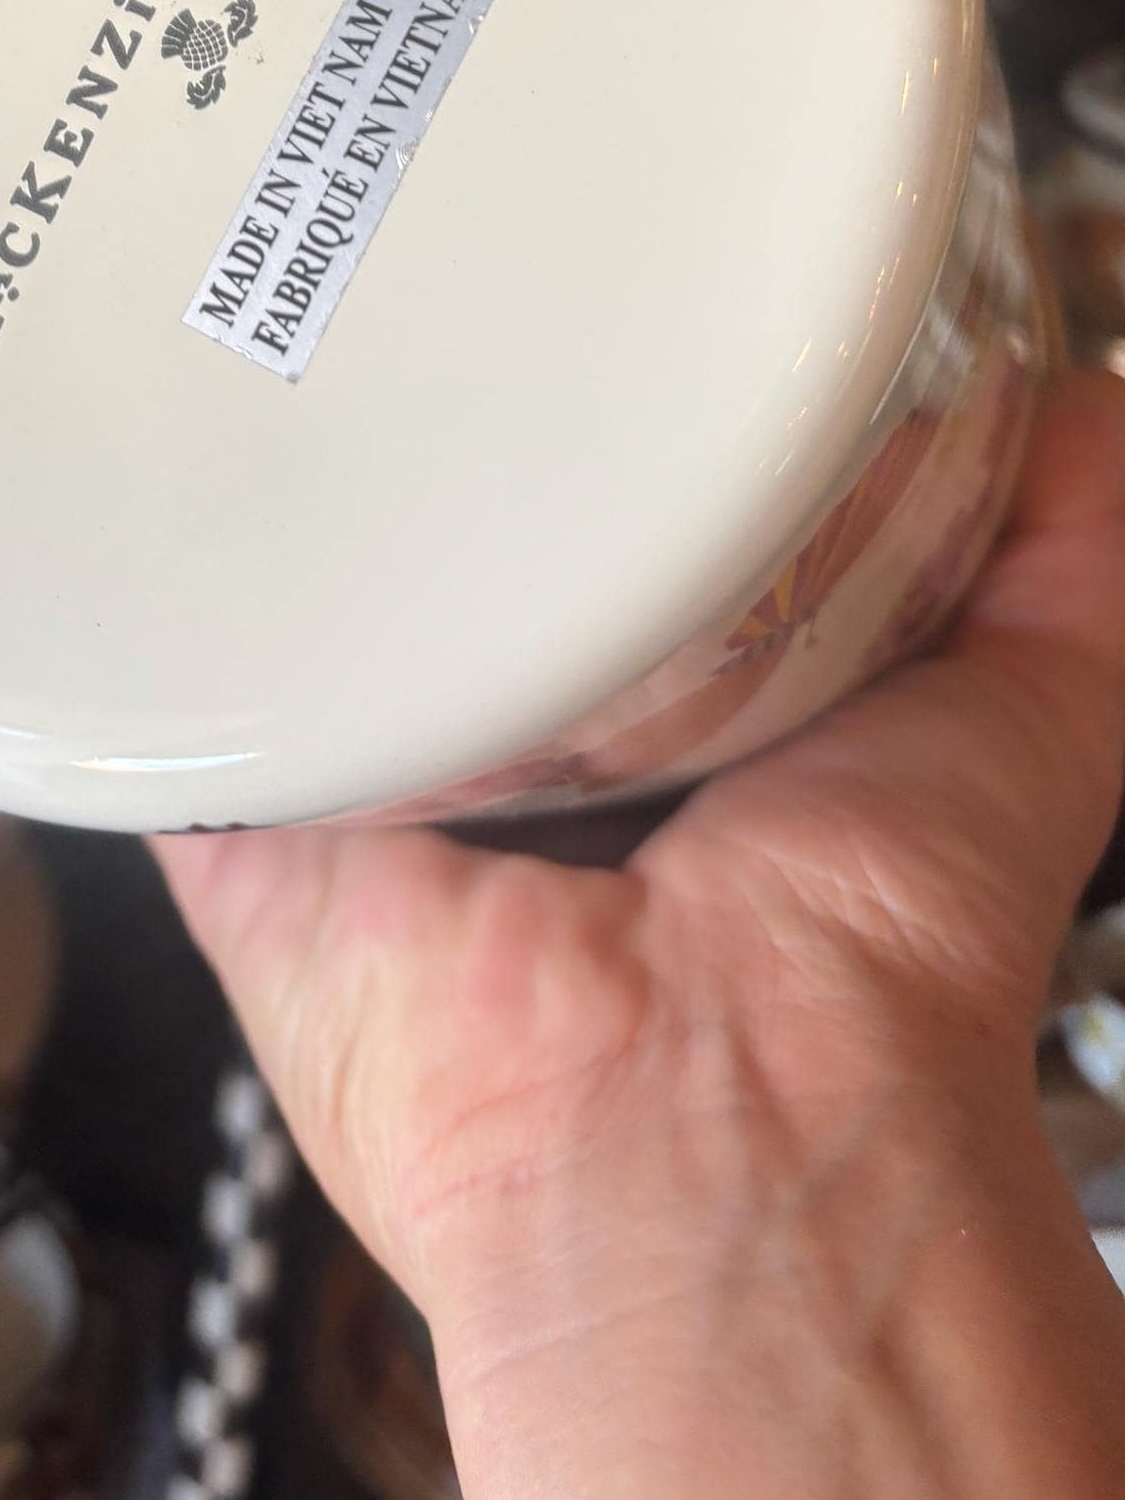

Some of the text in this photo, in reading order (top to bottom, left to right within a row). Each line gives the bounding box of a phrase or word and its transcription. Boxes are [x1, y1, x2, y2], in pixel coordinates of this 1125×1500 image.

[277, 81, 346, 170] VIET
[250, 168, 370, 356] FABRIQUÉ
[345, 114, 397, 172] EN
[254, 167, 304, 215] IN
[198, 212, 277, 328] MADE
